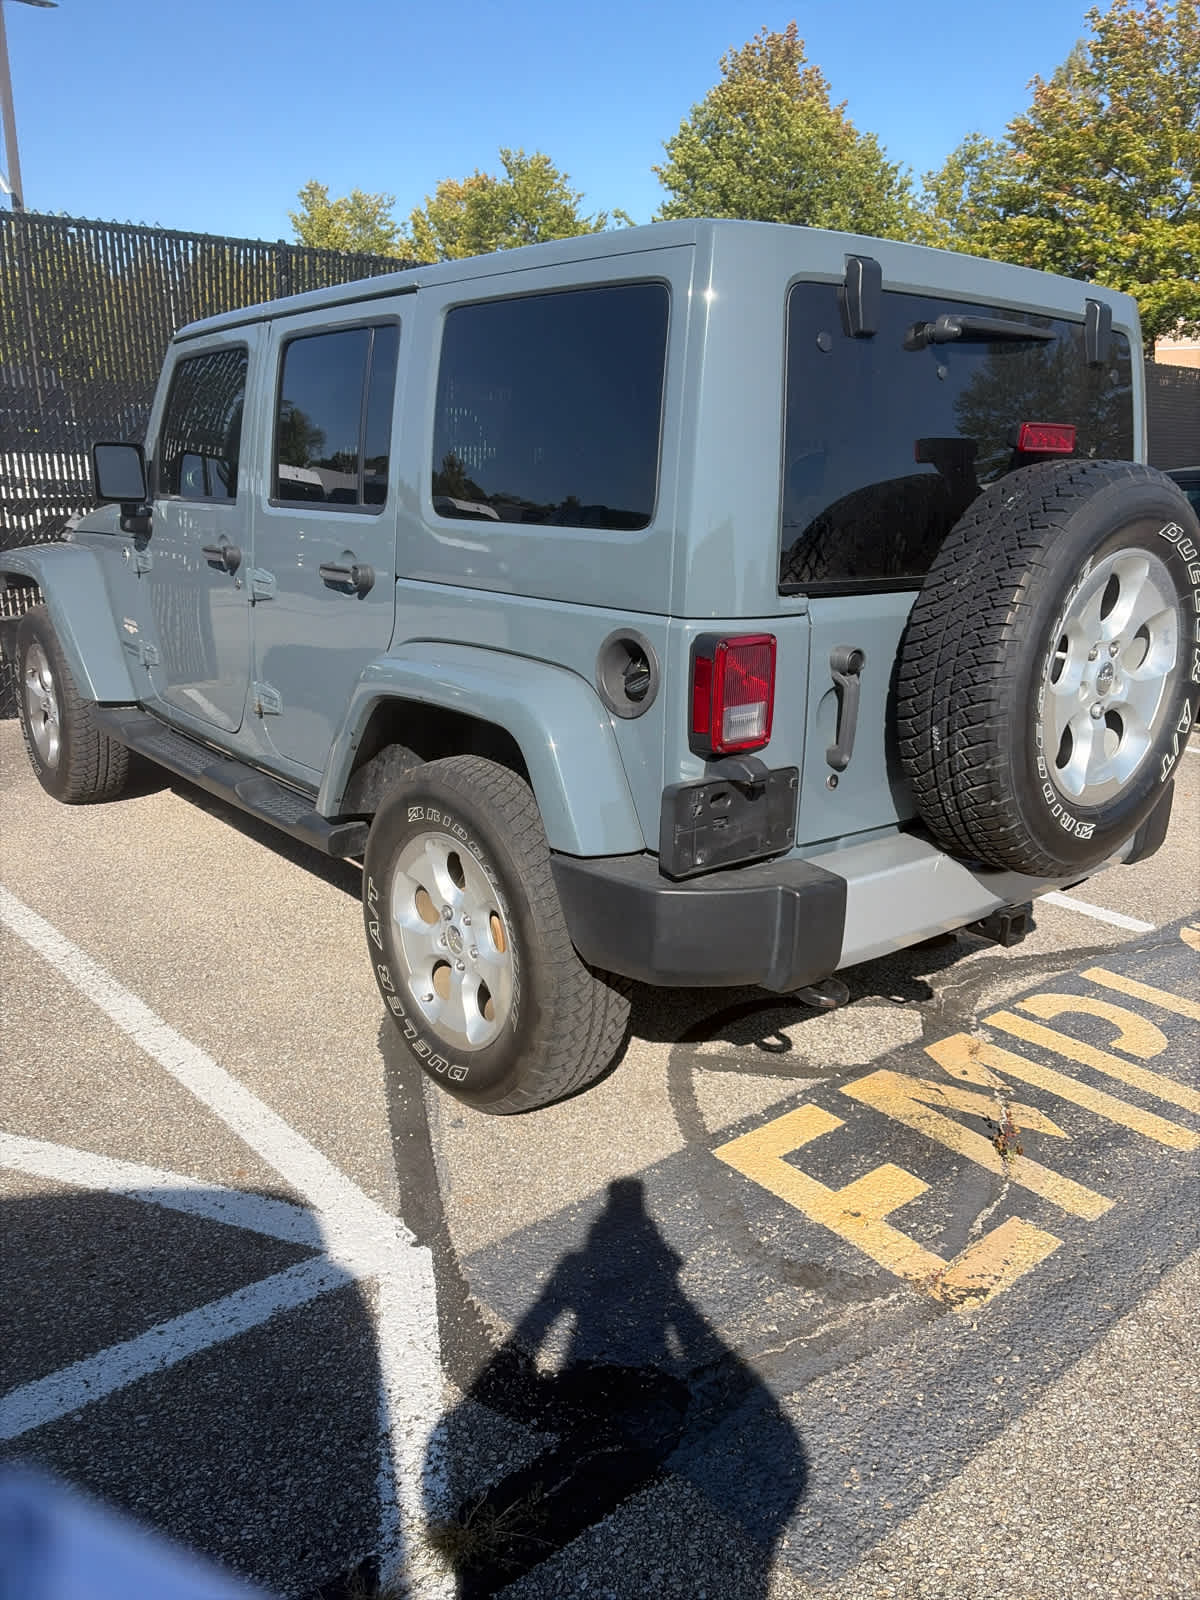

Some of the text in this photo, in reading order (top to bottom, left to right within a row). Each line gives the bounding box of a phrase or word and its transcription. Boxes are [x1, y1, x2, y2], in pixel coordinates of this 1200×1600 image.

[1161, 698, 1192, 782] A/T
[367, 876, 470, 1081] DUELER A/T
